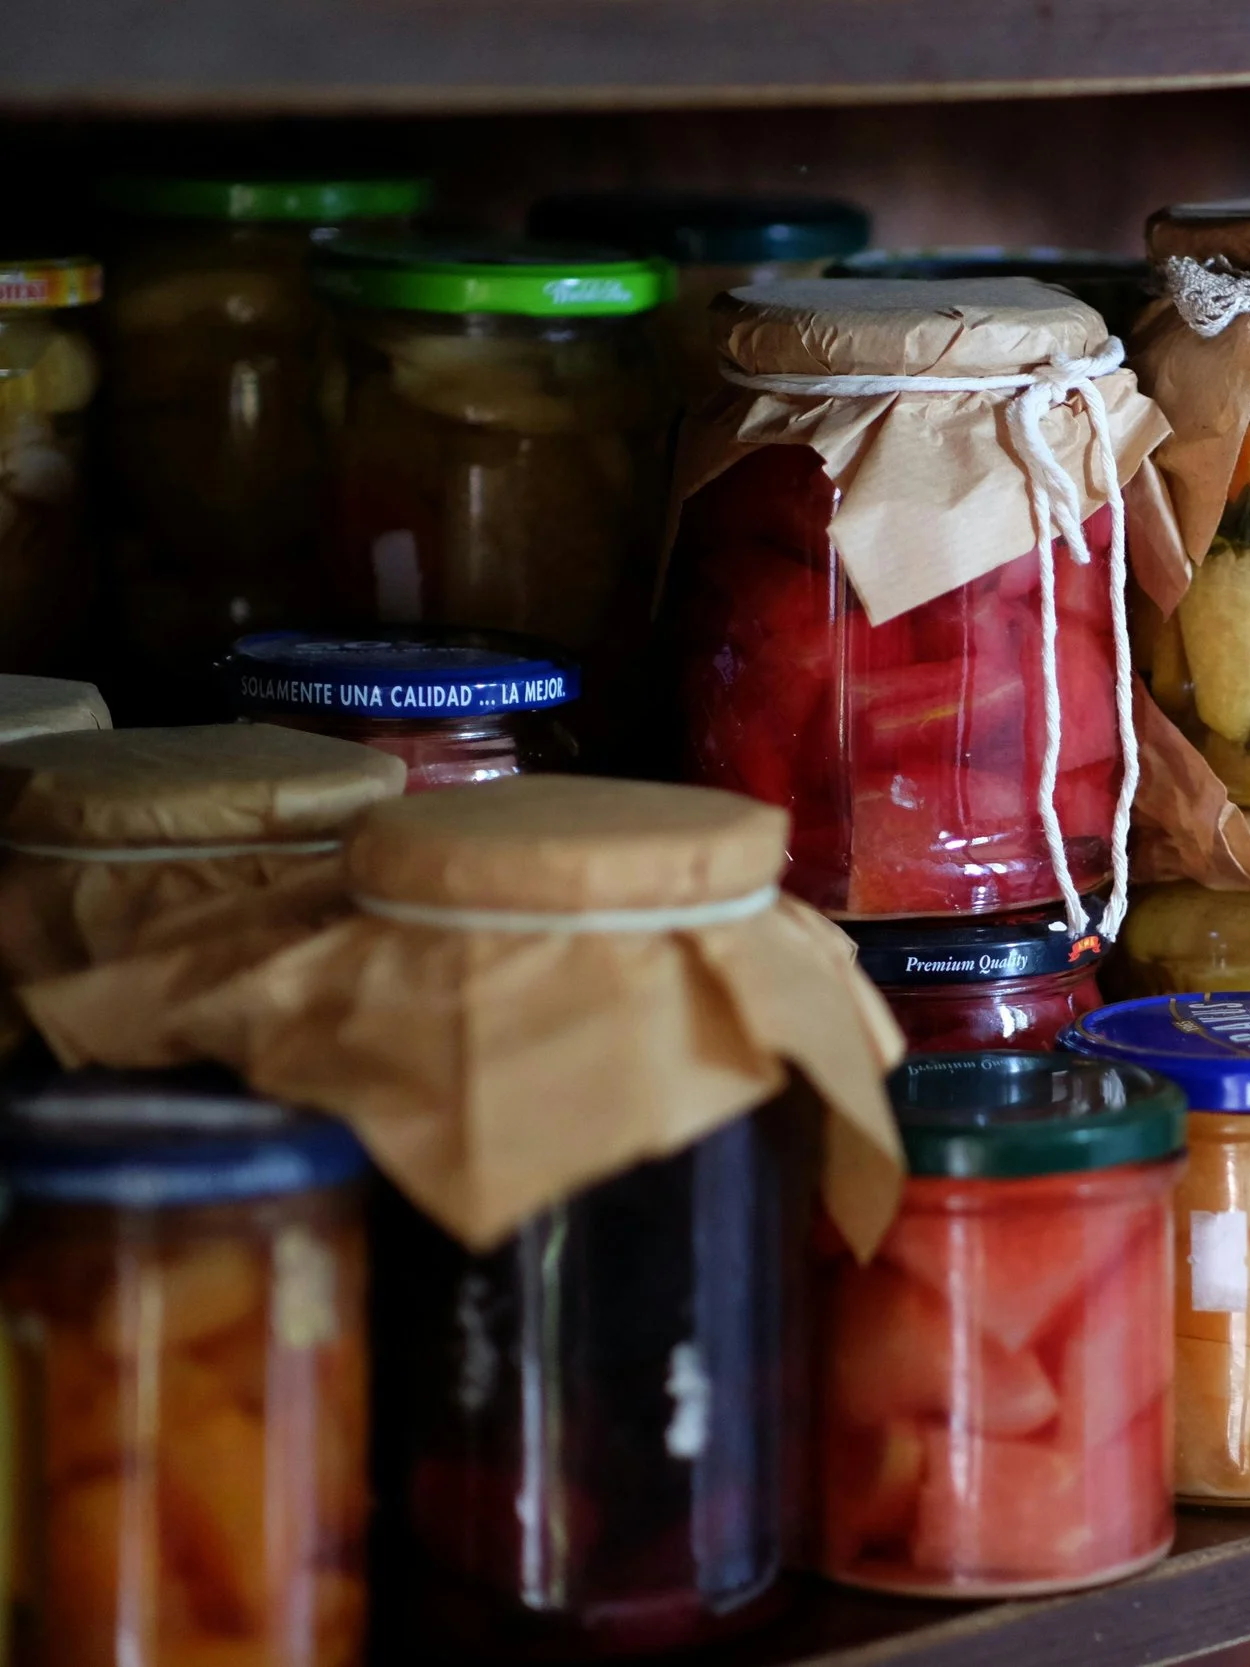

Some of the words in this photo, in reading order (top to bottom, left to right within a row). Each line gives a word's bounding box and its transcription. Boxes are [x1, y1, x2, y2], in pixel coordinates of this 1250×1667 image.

[240, 675, 333, 706] SOLAMENTE
[340, 684, 384, 708] UNA
[390, 685, 473, 708] CALIDAD
[501, 682, 520, 705] LA
[524, 676, 567, 703] MEJOR.
[905, 955, 976, 973] Premium
[978, 952, 1029, 975] Quality
